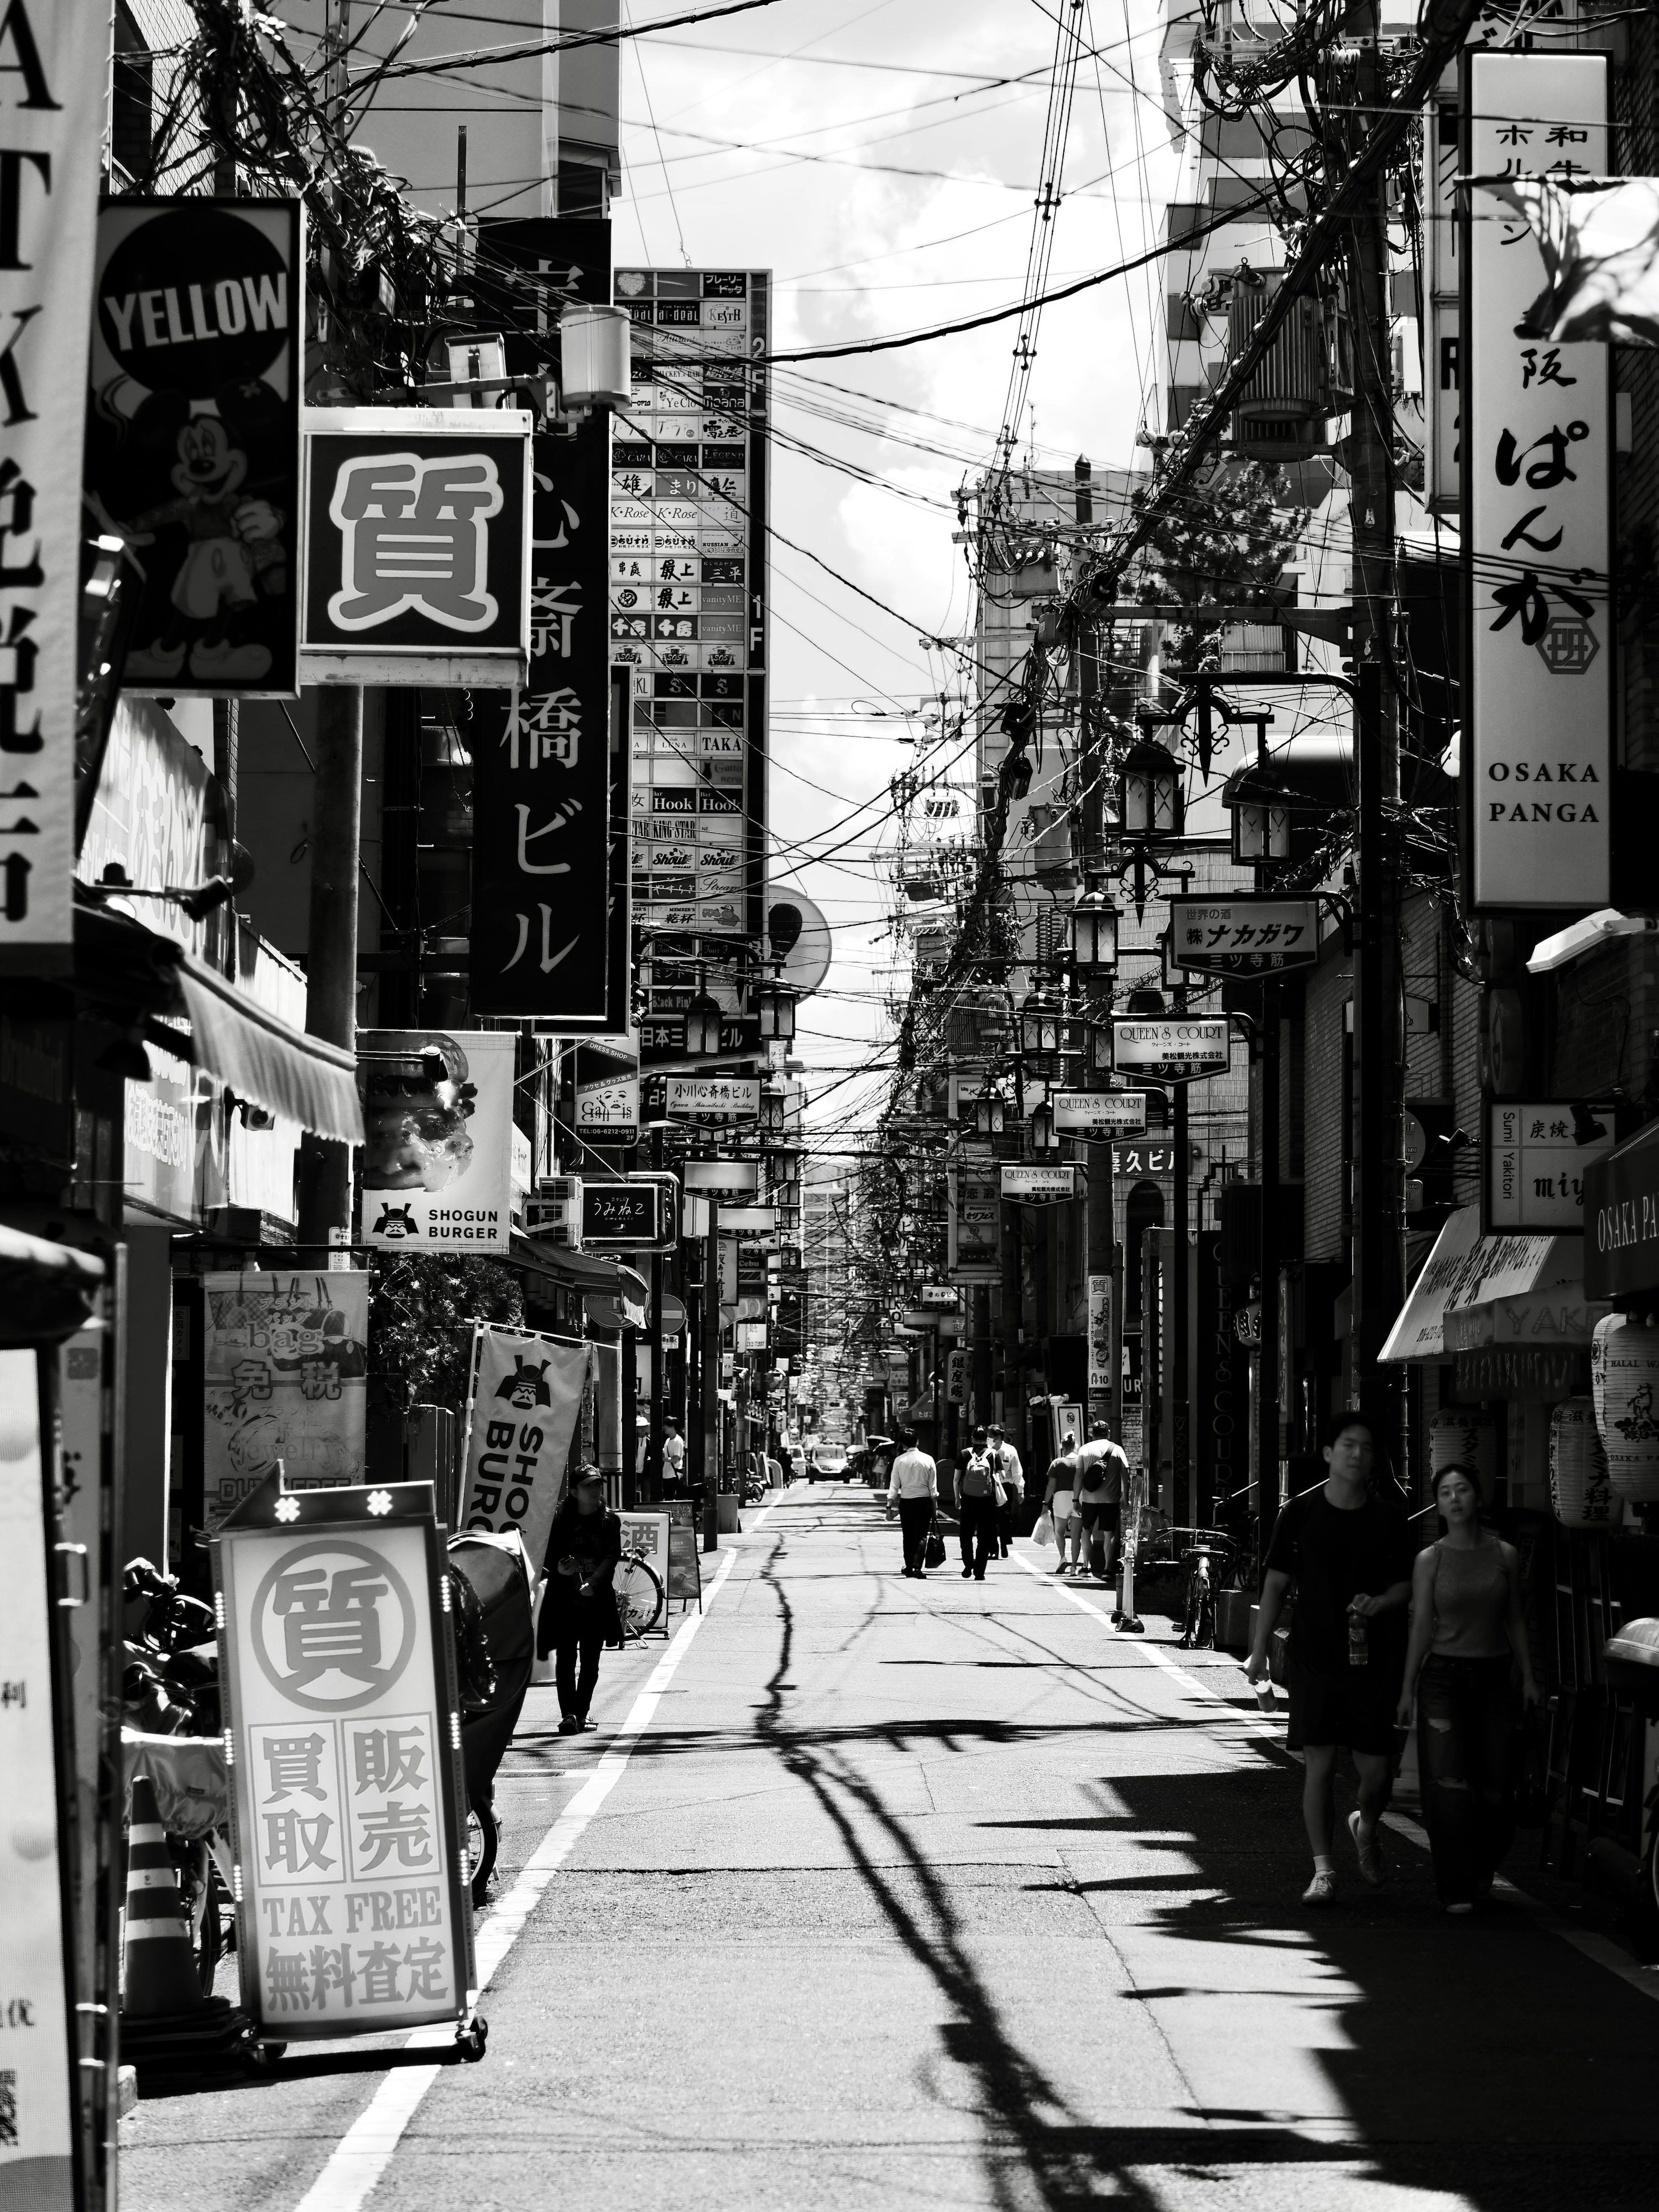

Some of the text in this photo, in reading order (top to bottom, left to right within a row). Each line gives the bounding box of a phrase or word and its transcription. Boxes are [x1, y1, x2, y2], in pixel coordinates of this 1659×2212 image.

[104, 273, 288, 351] YELLOW
[705, 450, 744, 459] LEGEND
[621, 474, 642, 493] 雄
[670, 479, 696, 494] まり
[723, 506, 743, 523] 道
[328, 452, 503, 633] 質
[660, 559, 694, 582] 最上
[709, 566, 742, 581] 三平
[658, 588, 692, 610] 最上
[702, 738, 742, 750] TAKA
[1489, 763, 1600, 782] OSAKA
[654, 797, 693, 810] Hook
[1489, 803, 1599, 822] PANGA
[653, 853, 687, 865] Shout
[700, 854, 734, 865] Shout
[1186, 909, 1231, 920] 世界の酒
[1209, 953, 1284, 968] 三ツ寺筋
[653, 995, 673, 1008] Black
[1120, 1025, 1223, 1044] QUEEN'S COURT
[589, 1042, 628, 1060] DRESS SHOP
[1161, 1051, 1223, 1060] 美松観光株式会社
[1142, 1063, 1202, 1074] 三ツ寺筋
[674, 1084, 752, 1099] 小川心斎橋ビル
[670, 1100, 688, 1109] Ogawa
[1058, 1098, 1142, 1111] QUEEN'S COURT
[688, 1113, 737, 1123] 三ツ寺筋
[1076, 1128, 1125, 1137] 三ツ寺筋
[1503, 1112, 1515, 1199] Sumi Yakitori
[1004, 1170, 1071, 1181] QUEEN'S COURT
[701, 1188, 739, 1197] 三ツ寺筋
[429, 1209, 498, 1222] SHOGUN
[1598, 1191, 1659, 1252] OSAKA PA
[429, 1227, 498, 1239] BURGER
[176, 1310, 184, 1355] 監視カメラ
[246, 1323, 325, 1354] bag
[231, 1359, 342, 1400] 免税
[1099, 1376, 1108, 1384] 10
[1460, 1427, 1480, 1473] スタミ
[620, 1520, 660, 1555] 酒
[263, 1732, 337, 1874] 買取
[353, 1725, 434, 1872] 販売
[263, 1886, 442, 1937] TAX FREE
[265, 1937, 448, 2012] 無料査定
